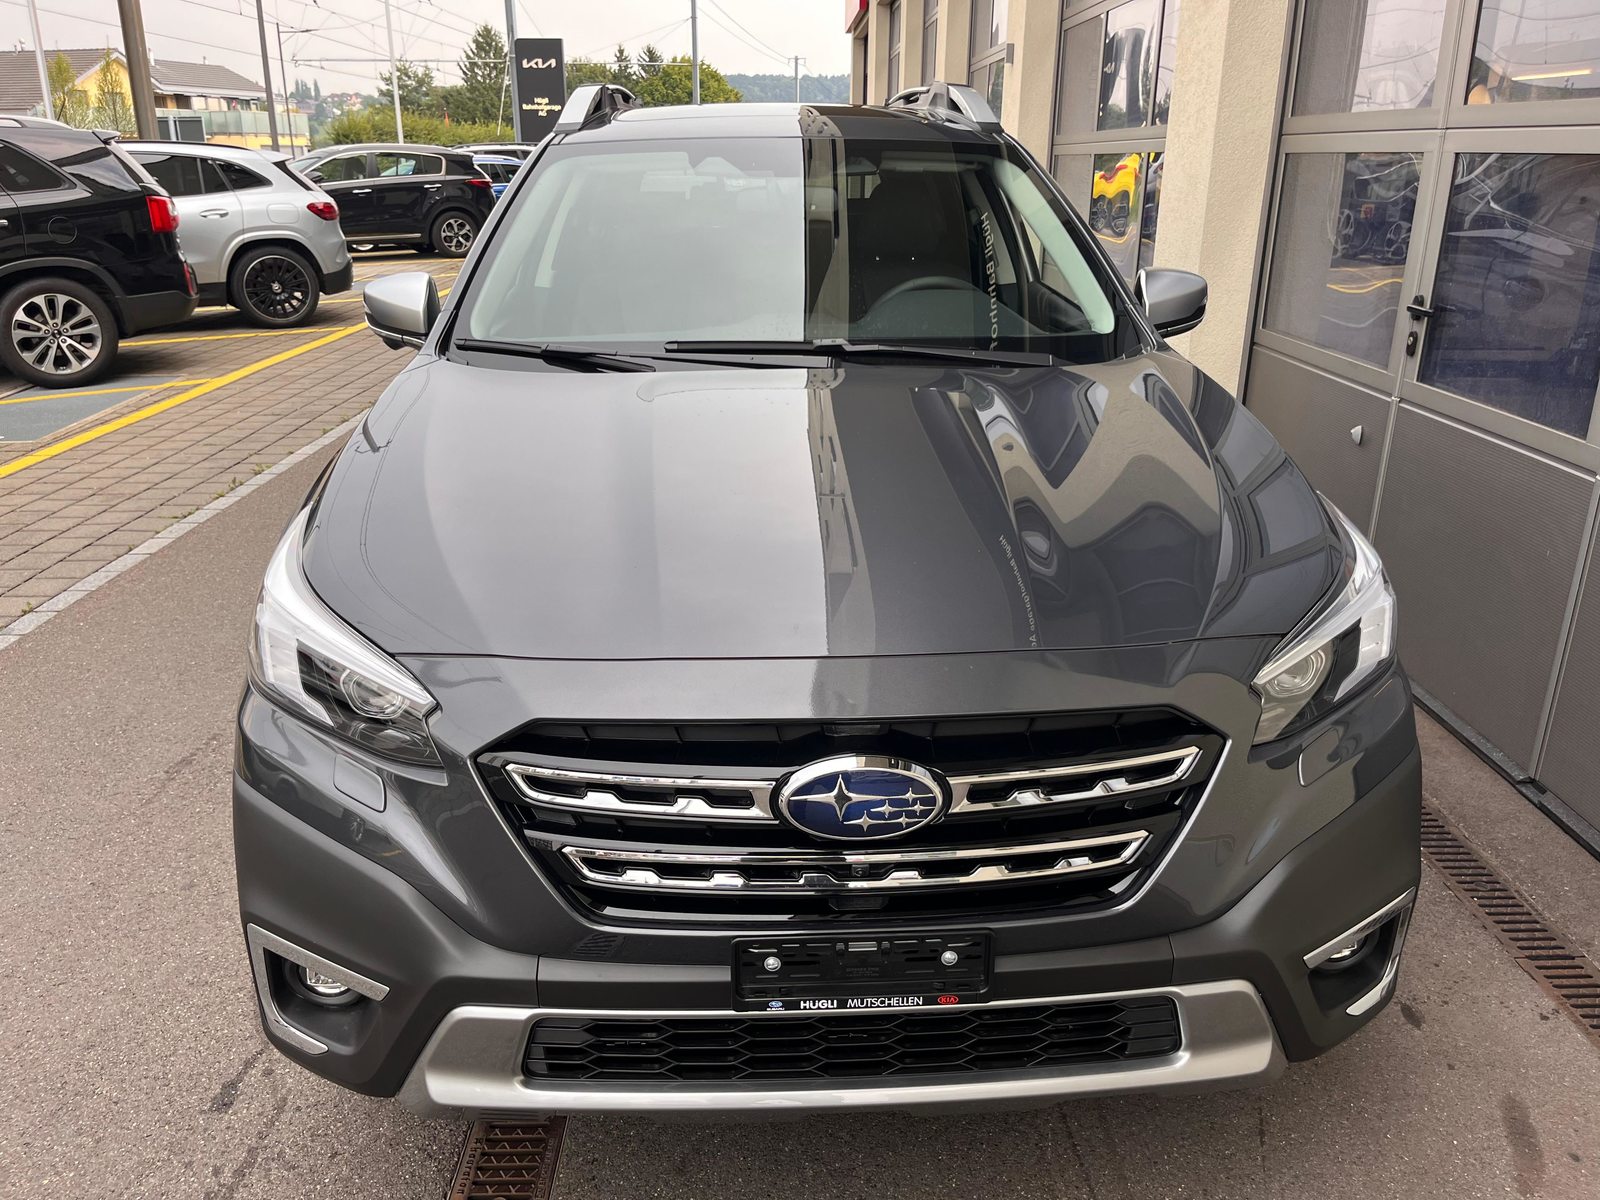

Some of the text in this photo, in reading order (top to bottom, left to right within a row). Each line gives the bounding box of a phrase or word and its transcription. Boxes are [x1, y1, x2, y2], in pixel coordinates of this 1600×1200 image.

[522, 58, 556, 68] KIA
[847, 996, 923, 1008] MUTSCHELLEN
[940, 996, 956, 1004] KIA
